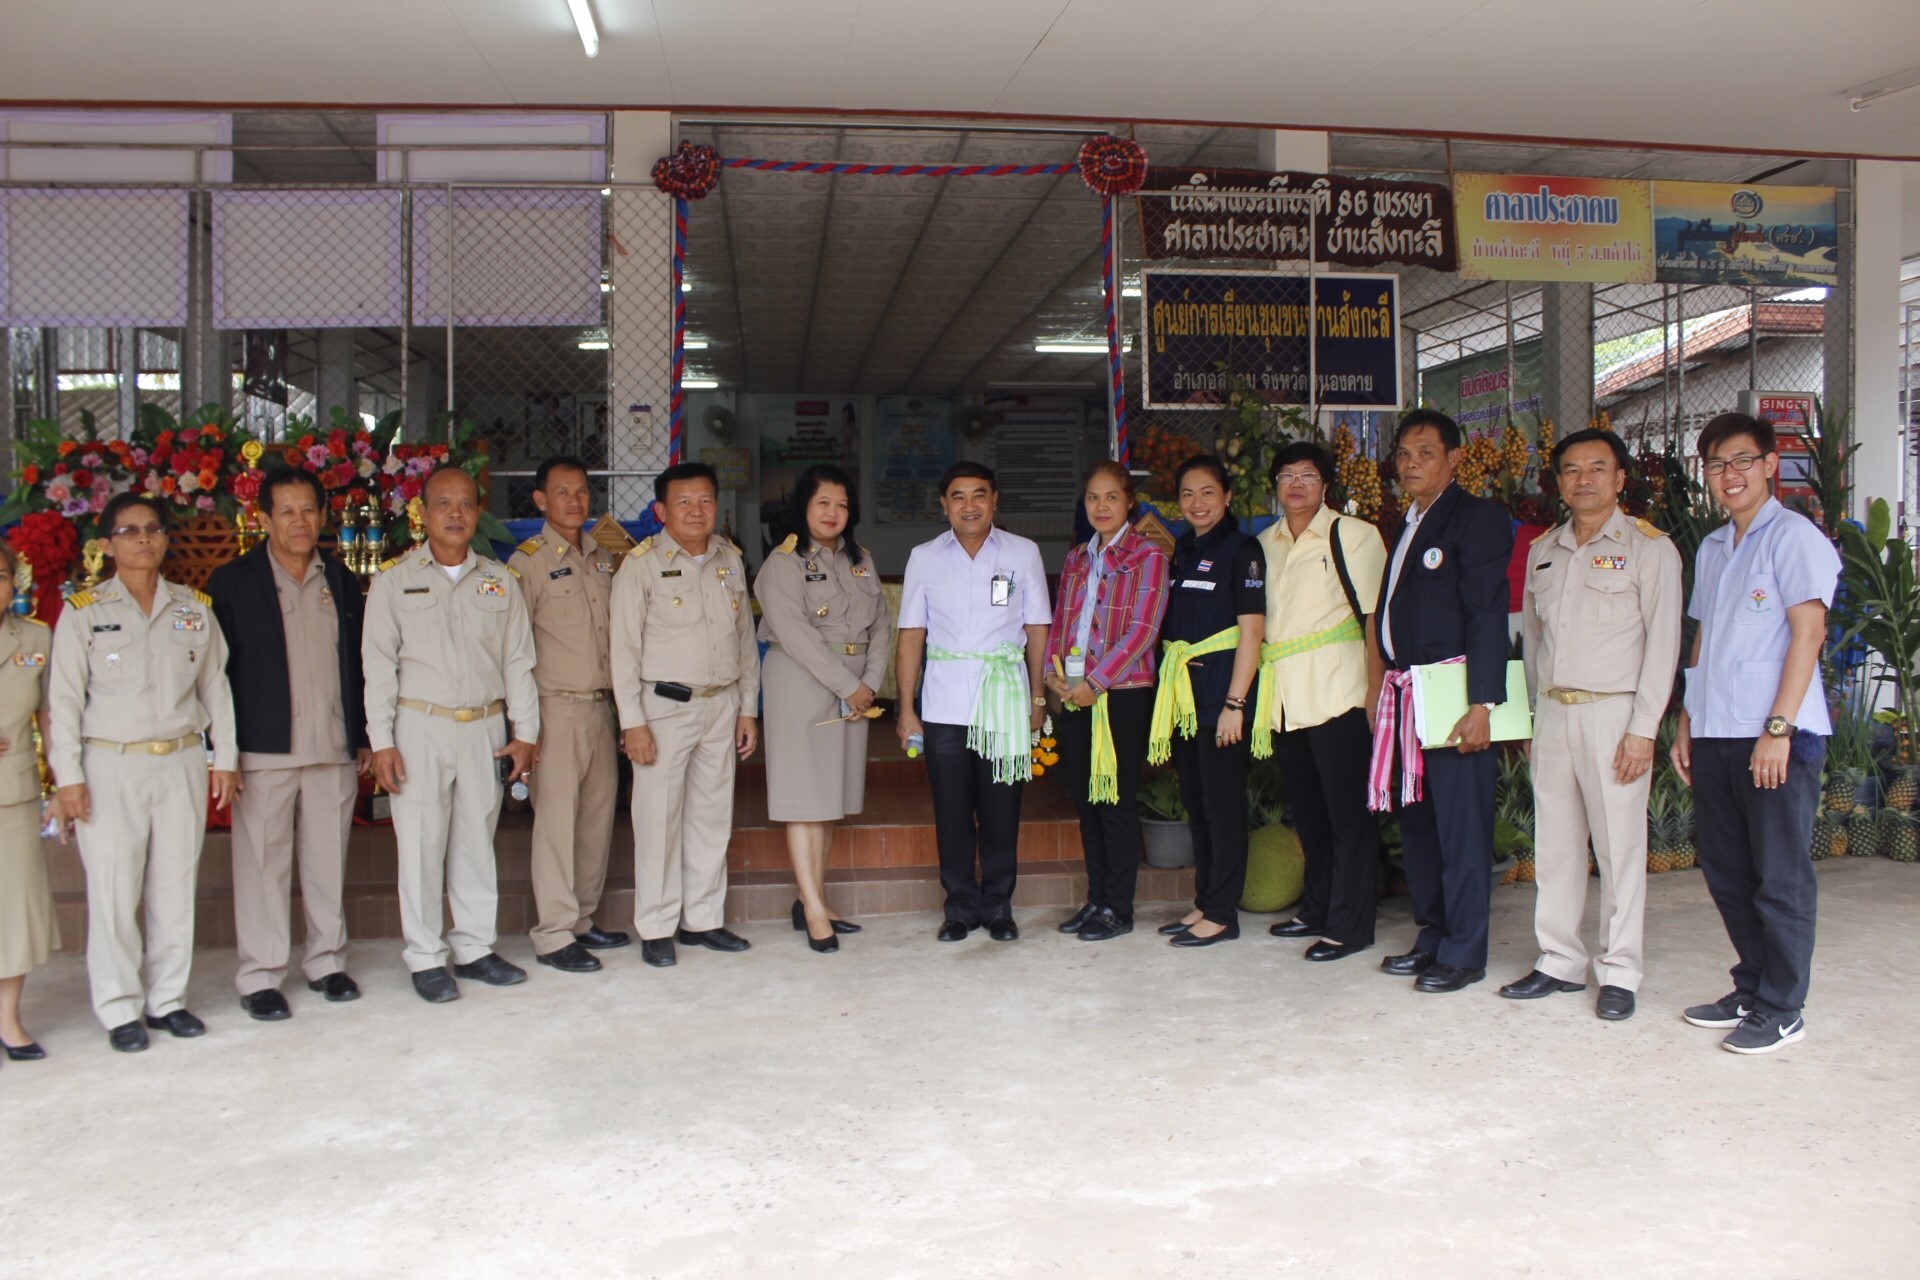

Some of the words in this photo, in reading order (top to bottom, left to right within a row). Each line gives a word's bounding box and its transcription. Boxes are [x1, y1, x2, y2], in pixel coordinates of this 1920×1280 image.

[1338, 188, 1369, 217] 86
[1373, 190, 1433, 218] พรรษา
[1485, 187, 1618, 225] ศาลาประชาคม
[1163, 217, 1311, 254] ศาลาประชาคม
[1575, 244, 1584, 261] 5
[1461, 363, 1516, 399] ยินดีต้อนรั
[1761, 399, 1809, 410] SINGER
